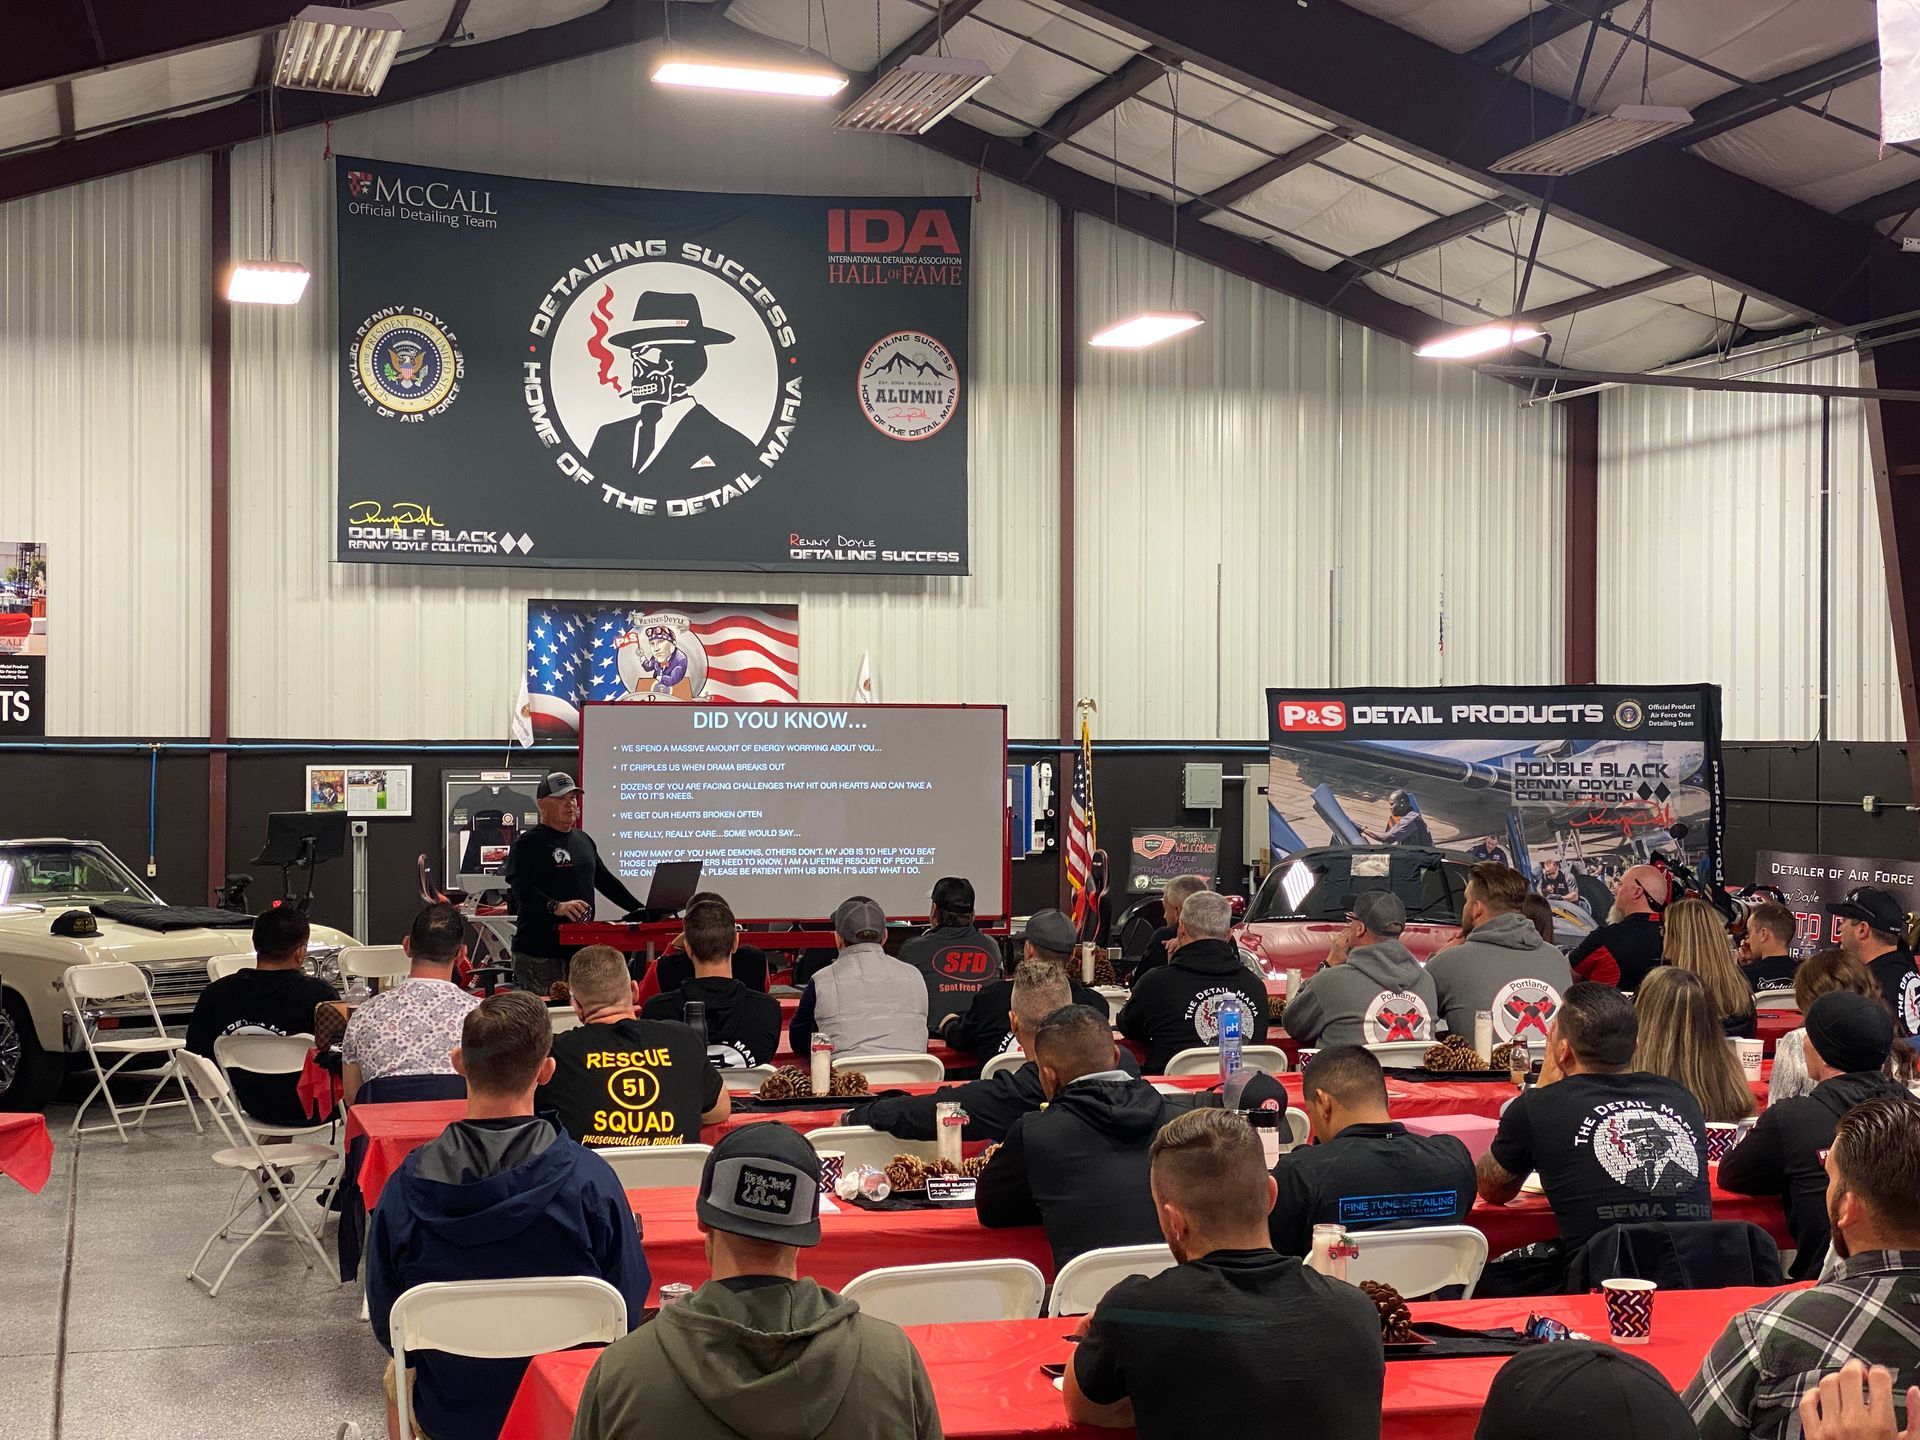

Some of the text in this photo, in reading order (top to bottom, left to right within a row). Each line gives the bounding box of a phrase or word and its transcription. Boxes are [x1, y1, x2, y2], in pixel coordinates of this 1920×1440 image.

[348, 202, 497, 229] Official Detailing Team
[827, 208, 961, 254] IDA
[828, 256, 962, 265] INTERNATIONAL DETAILING ASSOCIATION
[828, 265, 962, 286] HALL OF FAME
[529, 239, 797, 349] DETAILING SUCCESS
[357, 305, 457, 340] RENNY DOYLE
[365, 318, 410, 351] PRESIDENT
[864, 334, 953, 371] DETAILING SUCCESS
[349, 343, 465, 423] DETAILER OF AIR FORCE ONE
[875, 388, 944, 404] ALUMNI
[861, 384, 875, 414] HOME
[873, 414, 886, 426] OF
[888, 424, 906, 436] THE
[909, 420, 941, 436] DETAIL
[940, 387, 956, 420] MAFIA
[523, 361, 803, 518] HOME OF THE DETAIL MAFIA
[348, 527, 497, 543] DOUBLE BLACK
[348, 540, 497, 554] RENNY DOYLE COLLECTION
[790, 549, 960, 563] DETAILING SUCCESS
[693, 711, 728, 729] DID
[734, 711, 778, 729] YOU
[1283, 705, 1343, 727] P&S
[1353, 705, 1443, 725] DETAIL
[1451, 704, 1604, 724] PRODUCTS
[635, 744, 856, 753] SPEND MASSIVE AMOUNT ENERGY WORRYING ABOUT
[629, 762, 785, 772] CRIPPLES WHEN DRAMA BREAKS OUT
[1514, 762, 1670, 779] DOUBLE BLACK
[620, 781, 924, 791] DOZENS YOU ARE FACING CHALLENGES THAT HIT OUR HEARTS AND CAN TAKE
[1515, 779, 1633, 790] RENNY DOYLE
[620, 792, 636, 801] DAY
[666, 792, 694, 801] KNEES.
[1515, 791, 1633, 802] COLLECTION
[634, 810, 762, 820] GET OUR HEARTS BROKEN OFTEN
[634, 829, 777, 839] REALLY, REALLY WOULD
[623, 849, 648, 858] KNOW
[649, 849, 673, 858] MANY
[686, 849, 704, 858] YOU
[705, 849, 726, 858] HAVE
[727, 848, 764, 858] DEMONS,
[764, 848, 797, 857] OTHERS
[838, 848, 854, 857] JOB
[877, 847, 897, 856] HELP
[898, 847, 915, 856] YOU
[916, 847, 936, 856] BEAT
[619, 859, 646, 868] THOSE
[721, 858, 743, 867] NEED
[756, 858, 782, 867] KNOW,
[809, 857, 843, 866] LIFETIME
[844, 857, 881, 866] RESCUER
[619, 868, 638, 877] TAKE
[708, 867, 738, 876] PLEASE
[751, 867, 782, 876] PATIENT
[783, 867, 804, 876] WITH
[818, 867, 842, 876] BOTH.
[858, 866, 878, 875] JUST
[879, 866, 901, 875] WHAT
[906, 866, 920, 875] DO.
[1771, 863, 1914, 885] DETAILER OF AIR FORCE
[944, 952, 988, 973] SFD
[939, 983, 958, 992] Spot
[1509, 980, 1549, 992] Portland
[1184, 1000, 1198, 1020] THE
[1236, 990, 1259, 1017] MAFIA
[1226, 1023, 1238, 1034] pH
[586, 1048, 672, 1069] RESCUE
[622, 1078, 645, 1097] 51
[593, 1110, 675, 1133] SQUAD
[1574, 1100, 1698, 1147] THE DETAIL MAFIA
[582, 1134, 684, 1146] preservation project
[1344, 1197, 1454, 1211] FINE TUNE DETAILING
[1596, 1203, 1668, 1220] SEMA
